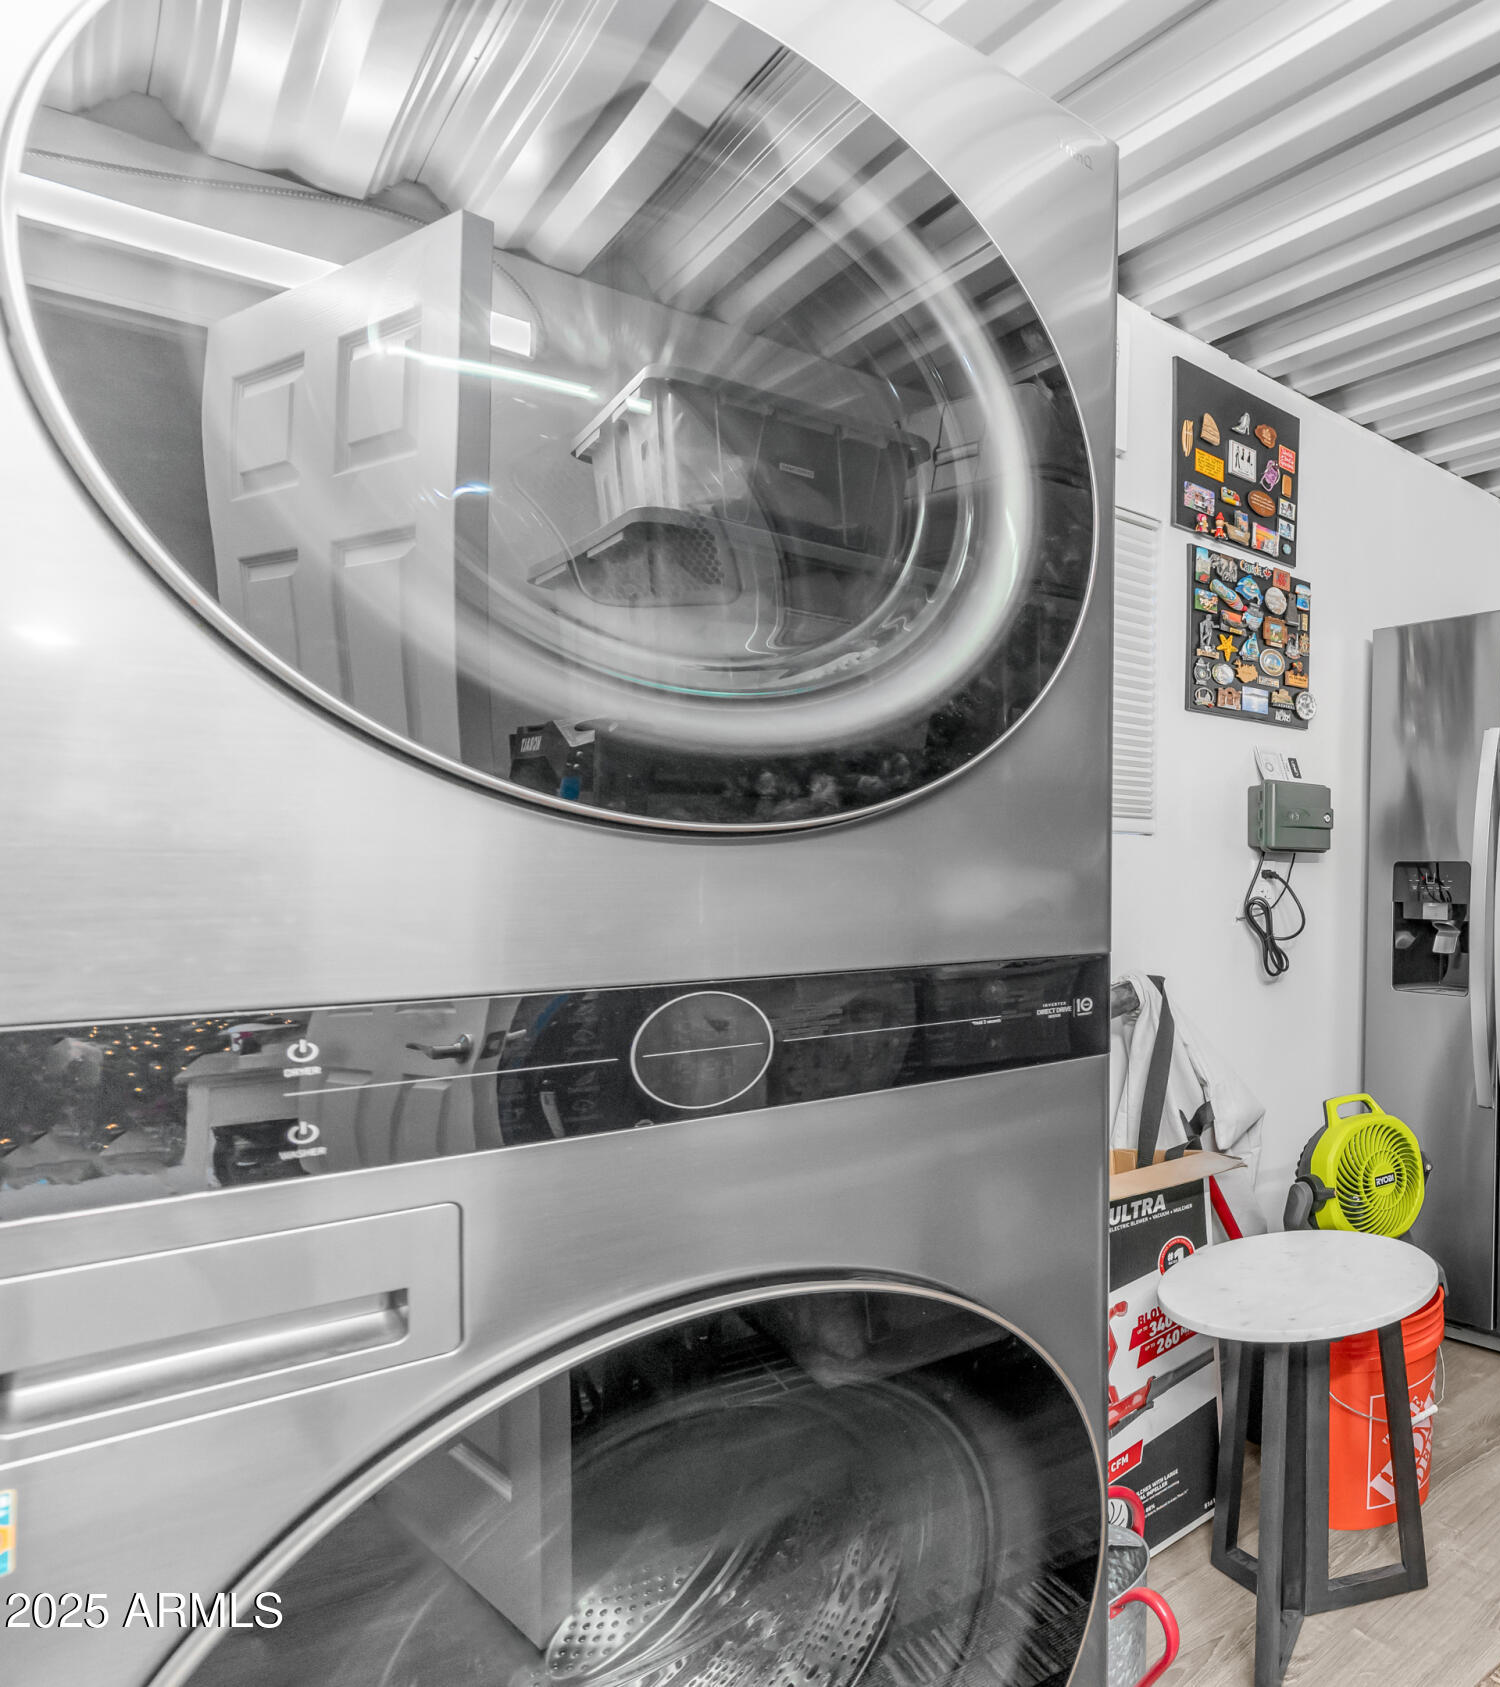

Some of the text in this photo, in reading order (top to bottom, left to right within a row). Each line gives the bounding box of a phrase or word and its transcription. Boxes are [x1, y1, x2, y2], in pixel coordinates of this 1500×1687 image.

[1375, 1174, 1394, 1186] RYOBI
[1109, 1194, 1166, 1226] ULTRA
[1109, 1203, 1193, 1233] ELECTRIC BLOWER VACUUM MULCHER
[1157, 1329, 1180, 1354] 260
[1110, 1453, 1129, 1472] CFM
